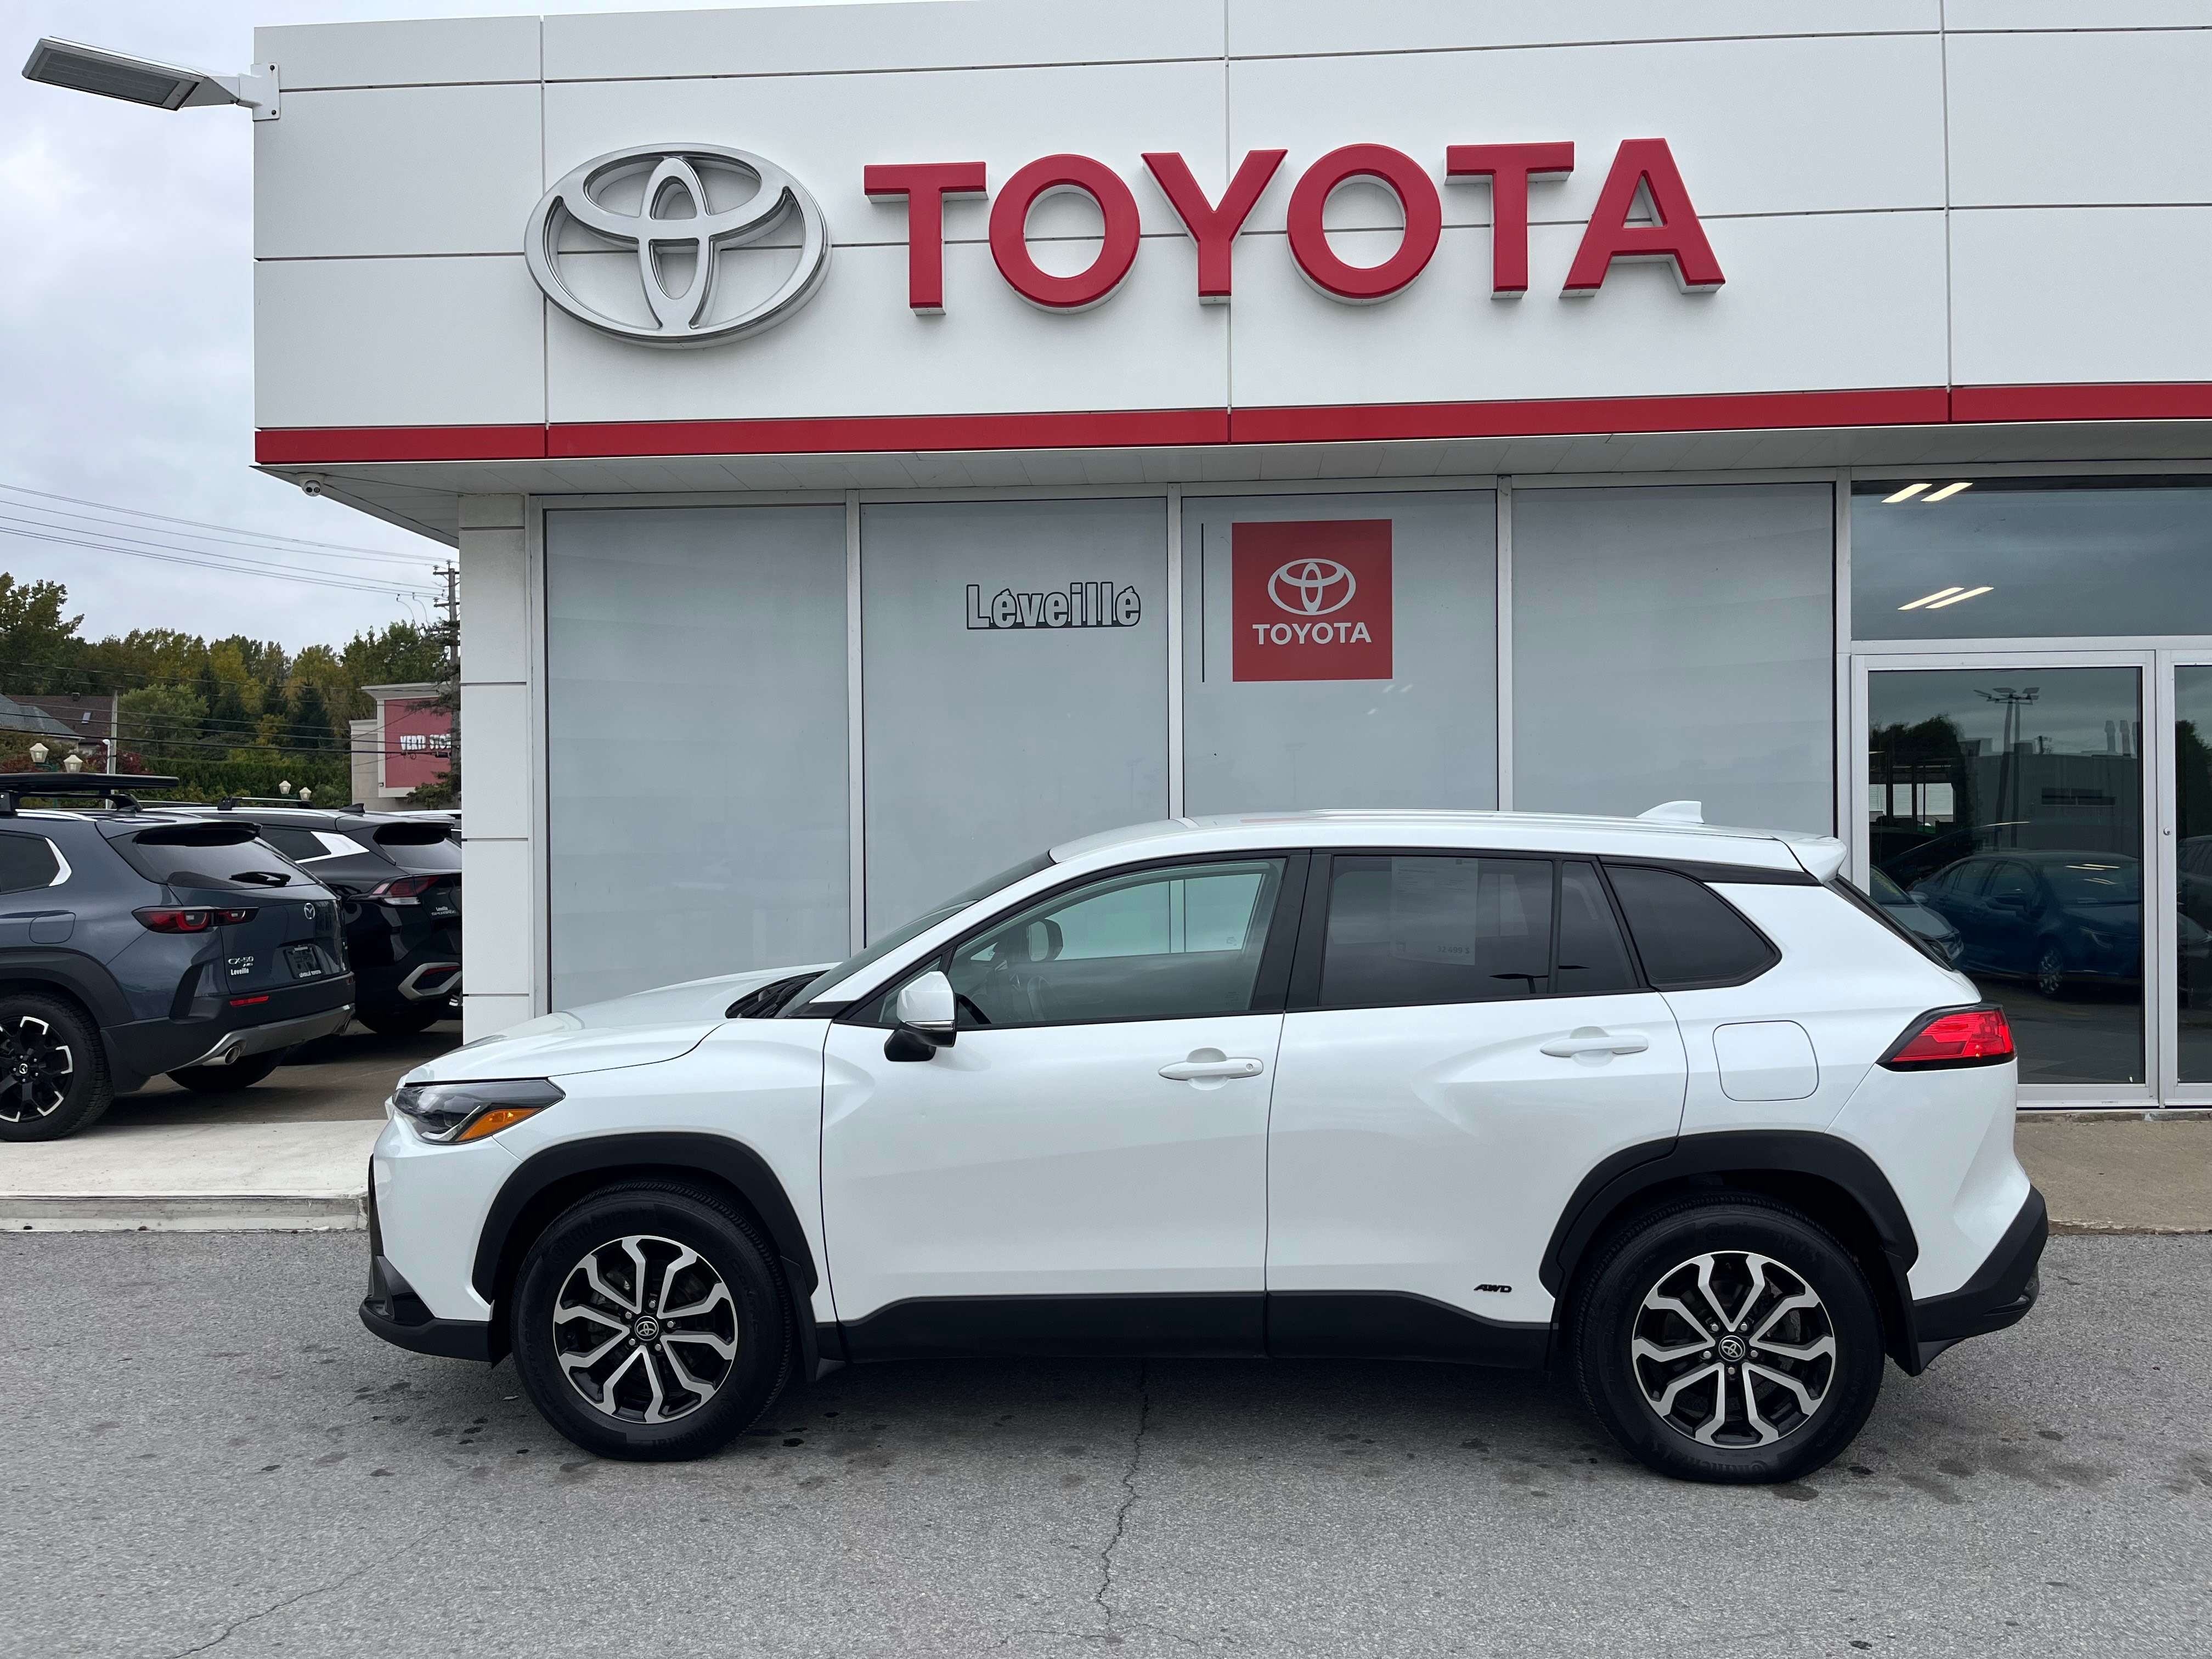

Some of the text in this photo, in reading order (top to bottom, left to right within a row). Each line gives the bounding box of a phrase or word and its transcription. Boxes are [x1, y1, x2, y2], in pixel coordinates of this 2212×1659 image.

[864, 138, 1726, 316] TOYOTA
[966, 582, 1141, 629] Léveillé
[1252, 622, 1372, 645] TOYOTA
[228, 956, 254, 965] CX-50
[1474, 1284, 1512, 1293] AWD
